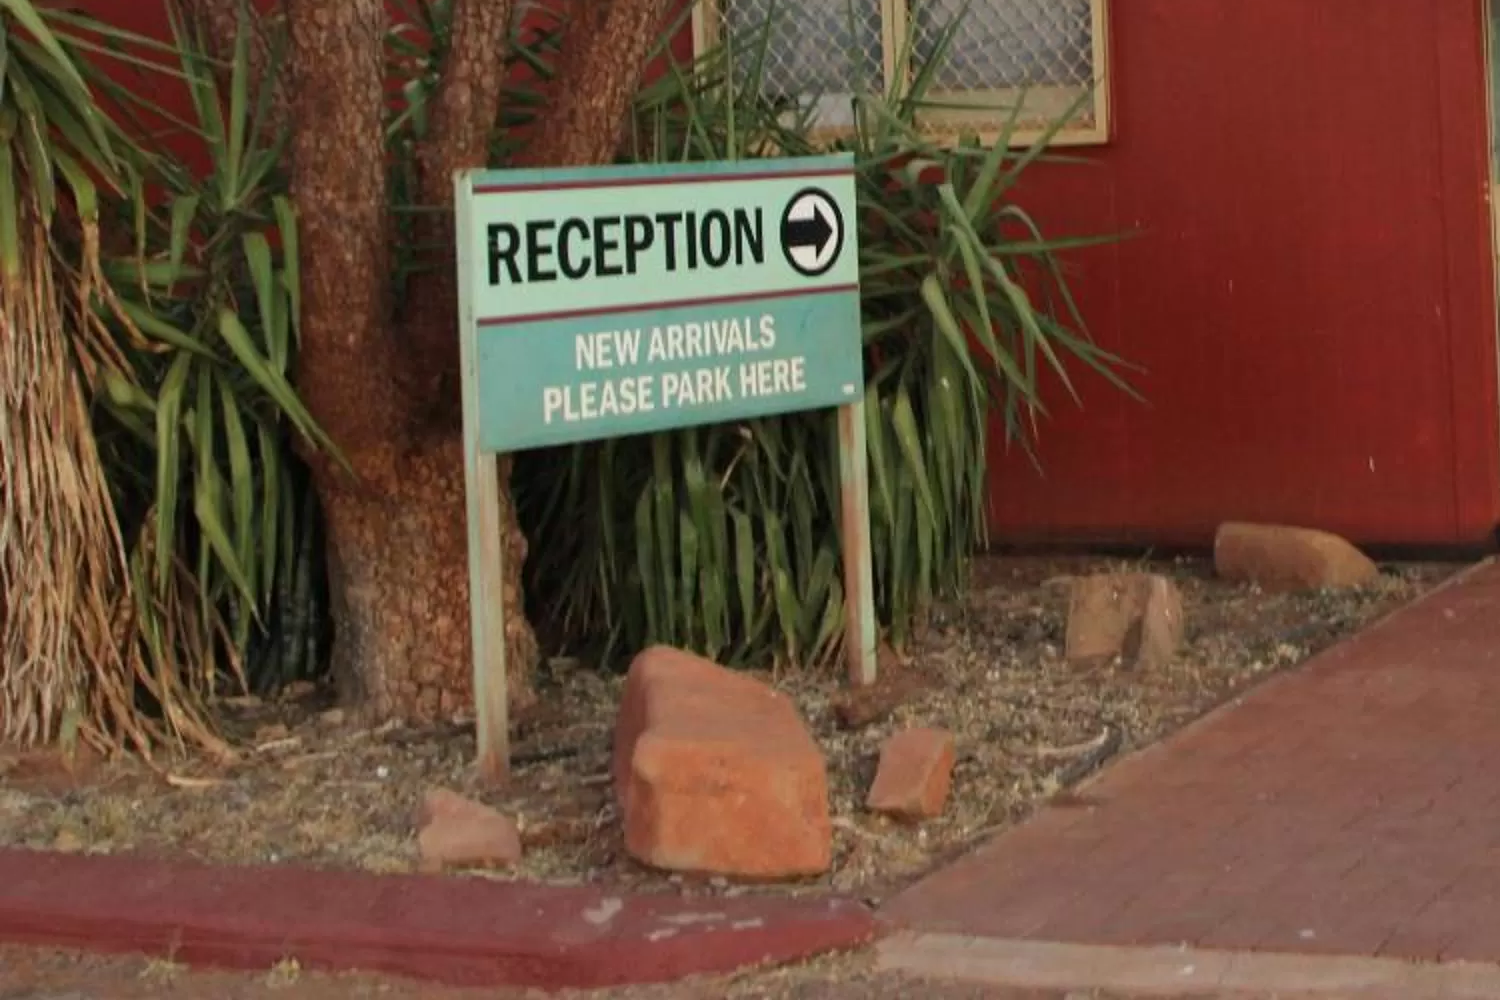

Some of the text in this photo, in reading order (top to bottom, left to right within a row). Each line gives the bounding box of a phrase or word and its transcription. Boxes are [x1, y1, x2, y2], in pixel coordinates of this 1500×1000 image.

[487, 206, 765, 286] RECEPTION
[575, 314, 777, 371] NEW ARRIVALS
[543, 356, 807, 425] PLEASE PARK HERE
